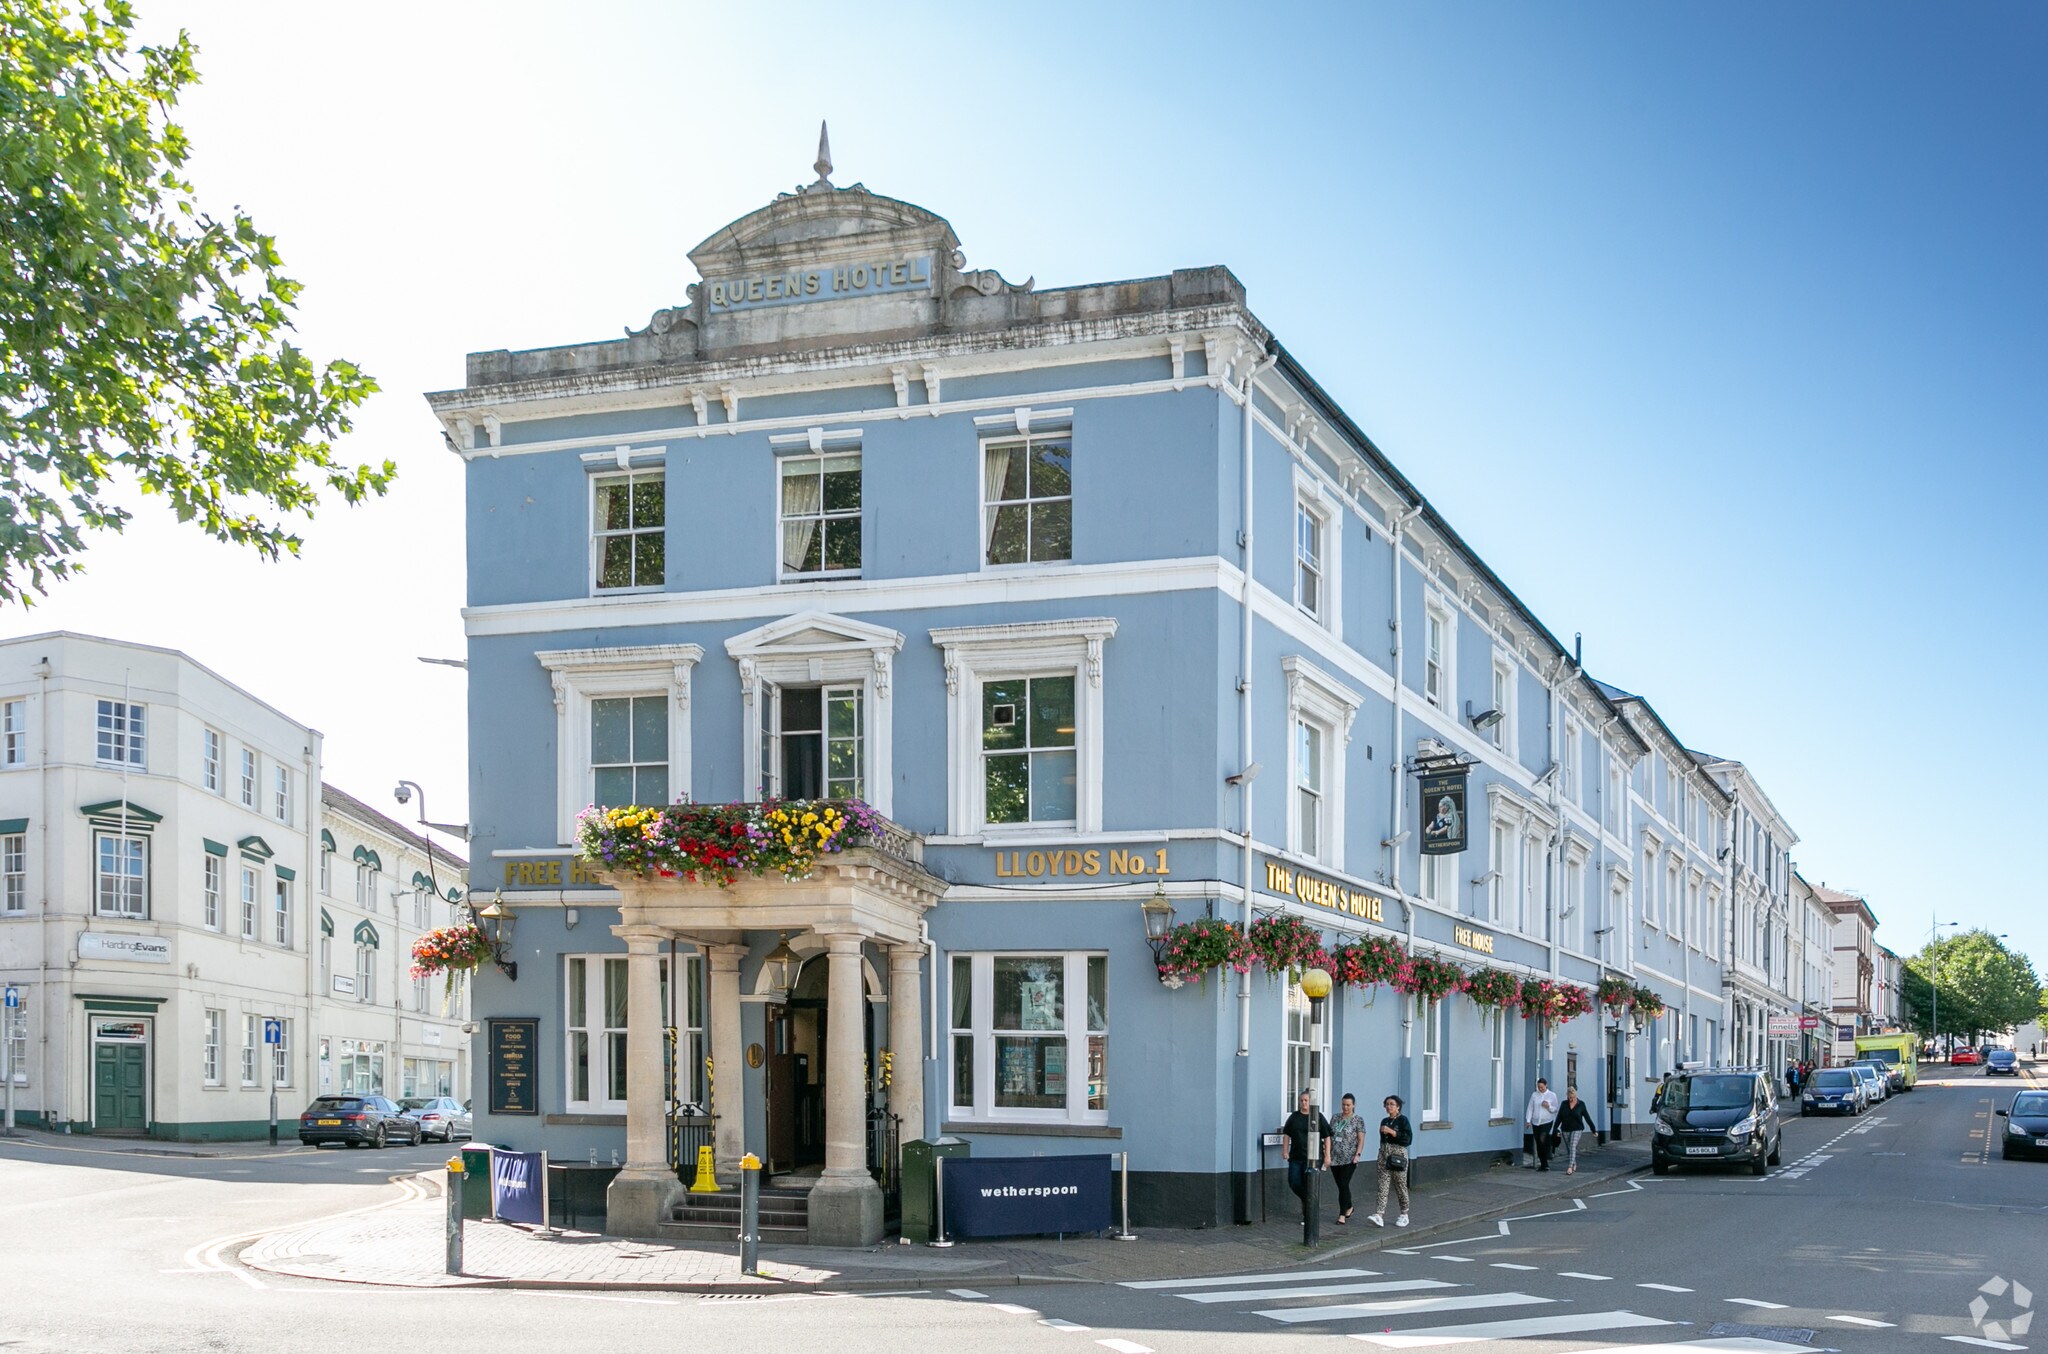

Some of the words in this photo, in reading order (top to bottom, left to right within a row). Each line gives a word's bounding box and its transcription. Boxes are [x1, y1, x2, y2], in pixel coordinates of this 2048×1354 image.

[710, 271, 820, 307] QUEENS
[832, 258, 926, 291] HOTEL
[505, 861, 562, 885] FREE
[996, 850, 1101, 877] LLOYDS
[1266, 862, 1293, 895] THE
[1296, 872, 1348, 911] QUEEN'S
[1349, 890, 1384, 922] HOTEL
[1454, 925, 1472, 947] FREE
[1472, 931, 1494, 954] HOUSE
[980, 1186, 1078, 1198] wetherspoon
